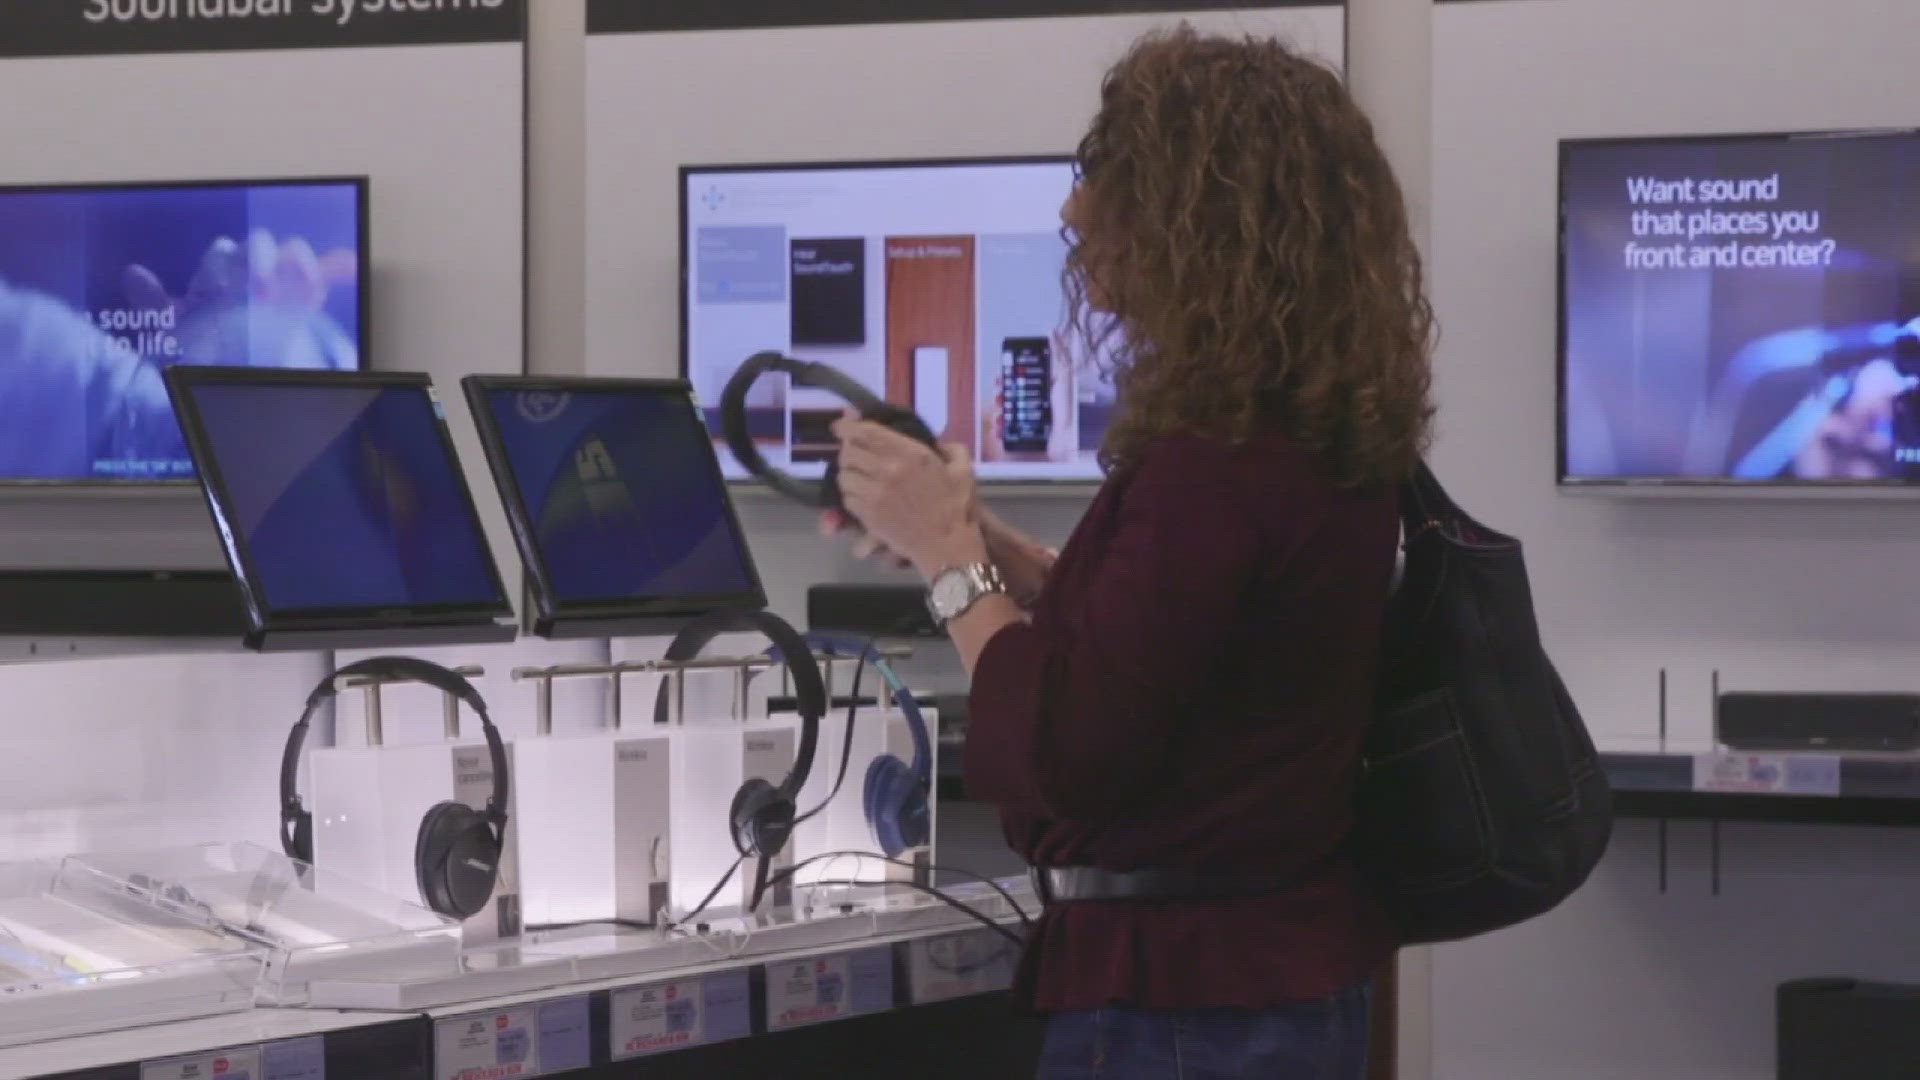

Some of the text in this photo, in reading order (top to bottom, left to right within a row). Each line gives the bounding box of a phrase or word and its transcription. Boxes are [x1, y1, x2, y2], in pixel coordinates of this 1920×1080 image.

[1627, 173, 1778, 203] Want sound
[1631, 208, 1819, 240] that places you
[1625, 239, 1836, 268] front and center?
[99, 305, 175, 330] sound
[138, 330, 184, 356] life.
